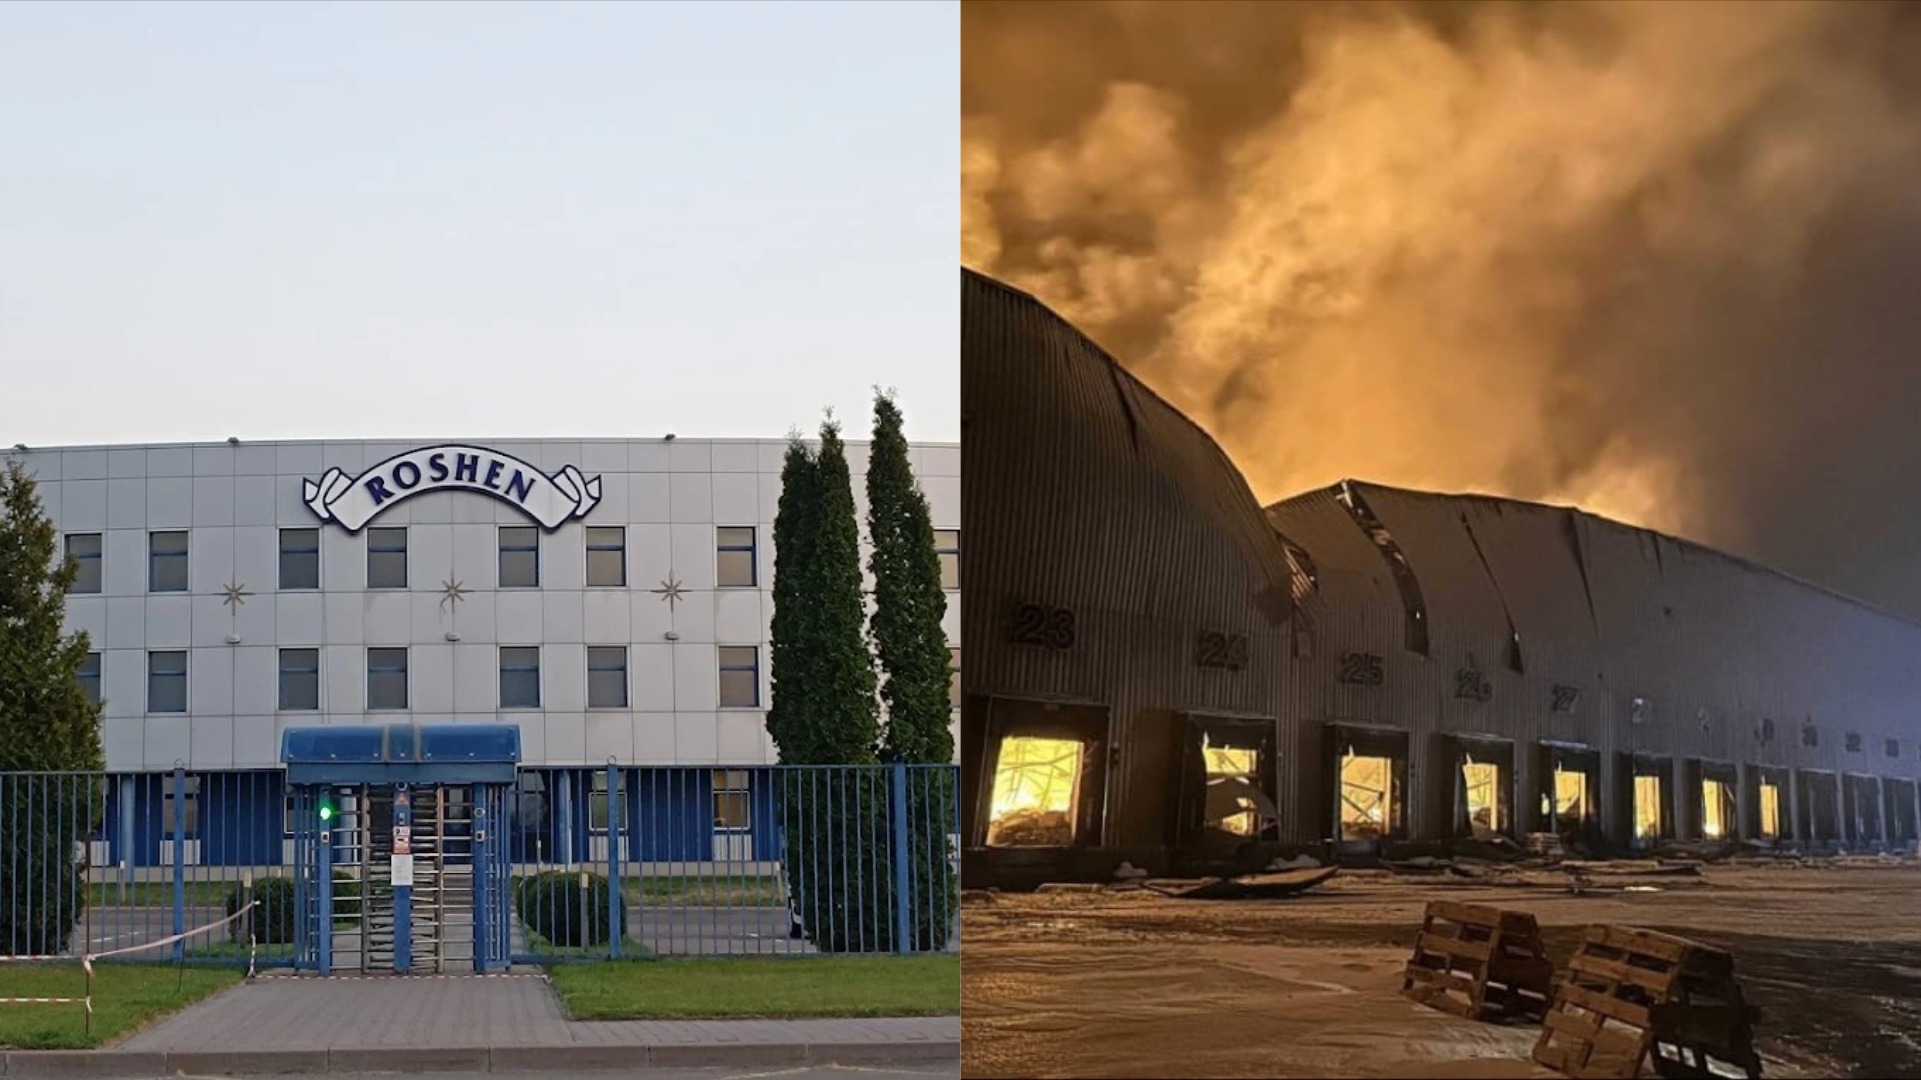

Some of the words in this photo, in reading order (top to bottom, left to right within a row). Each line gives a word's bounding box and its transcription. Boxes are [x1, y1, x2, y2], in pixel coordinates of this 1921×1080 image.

[363, 452, 537, 505] ROSHEN
[1013, 603, 1075, 650] 23
[1341, 653, 1384, 685] 25
